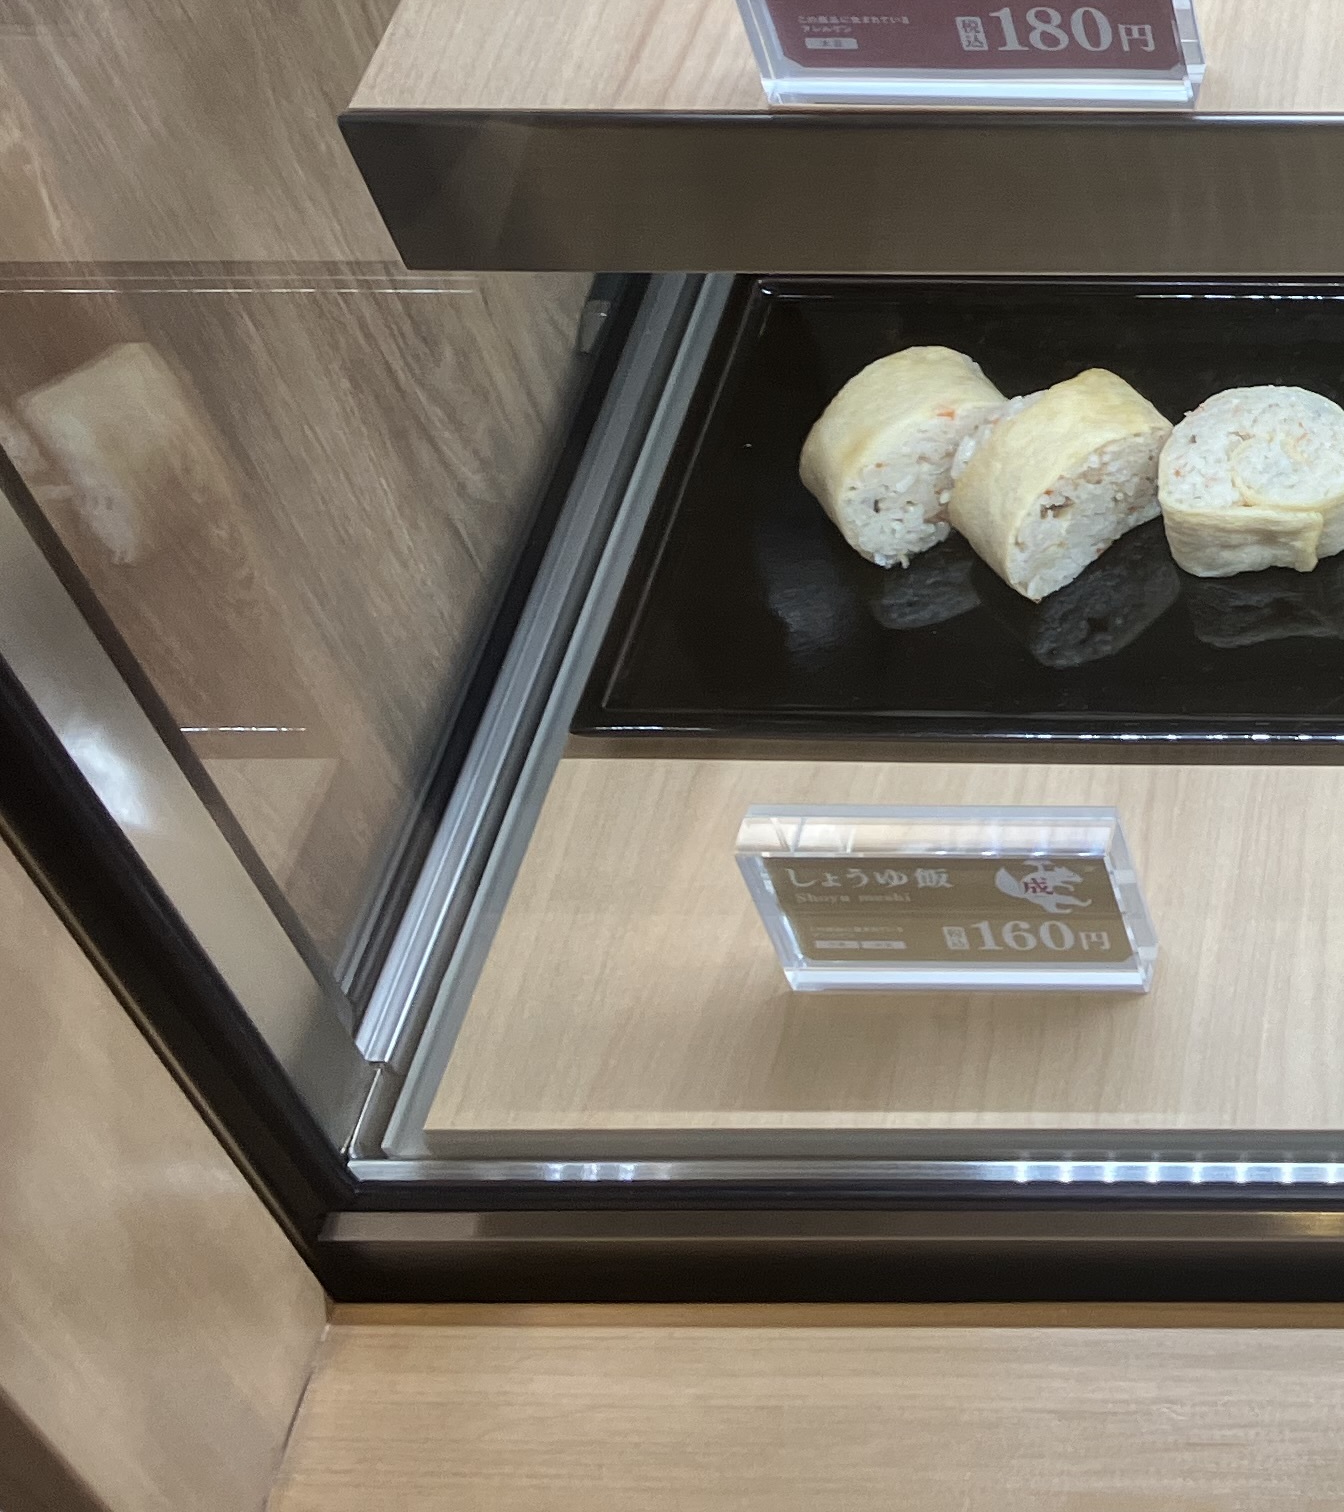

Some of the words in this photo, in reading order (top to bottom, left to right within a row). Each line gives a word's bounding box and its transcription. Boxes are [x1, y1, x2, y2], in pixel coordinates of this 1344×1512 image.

[989, 6, 1155, 52] 180円
[785, 868, 954, 888] しょうゆ飯
[971, 920, 1110, 950] 160円
